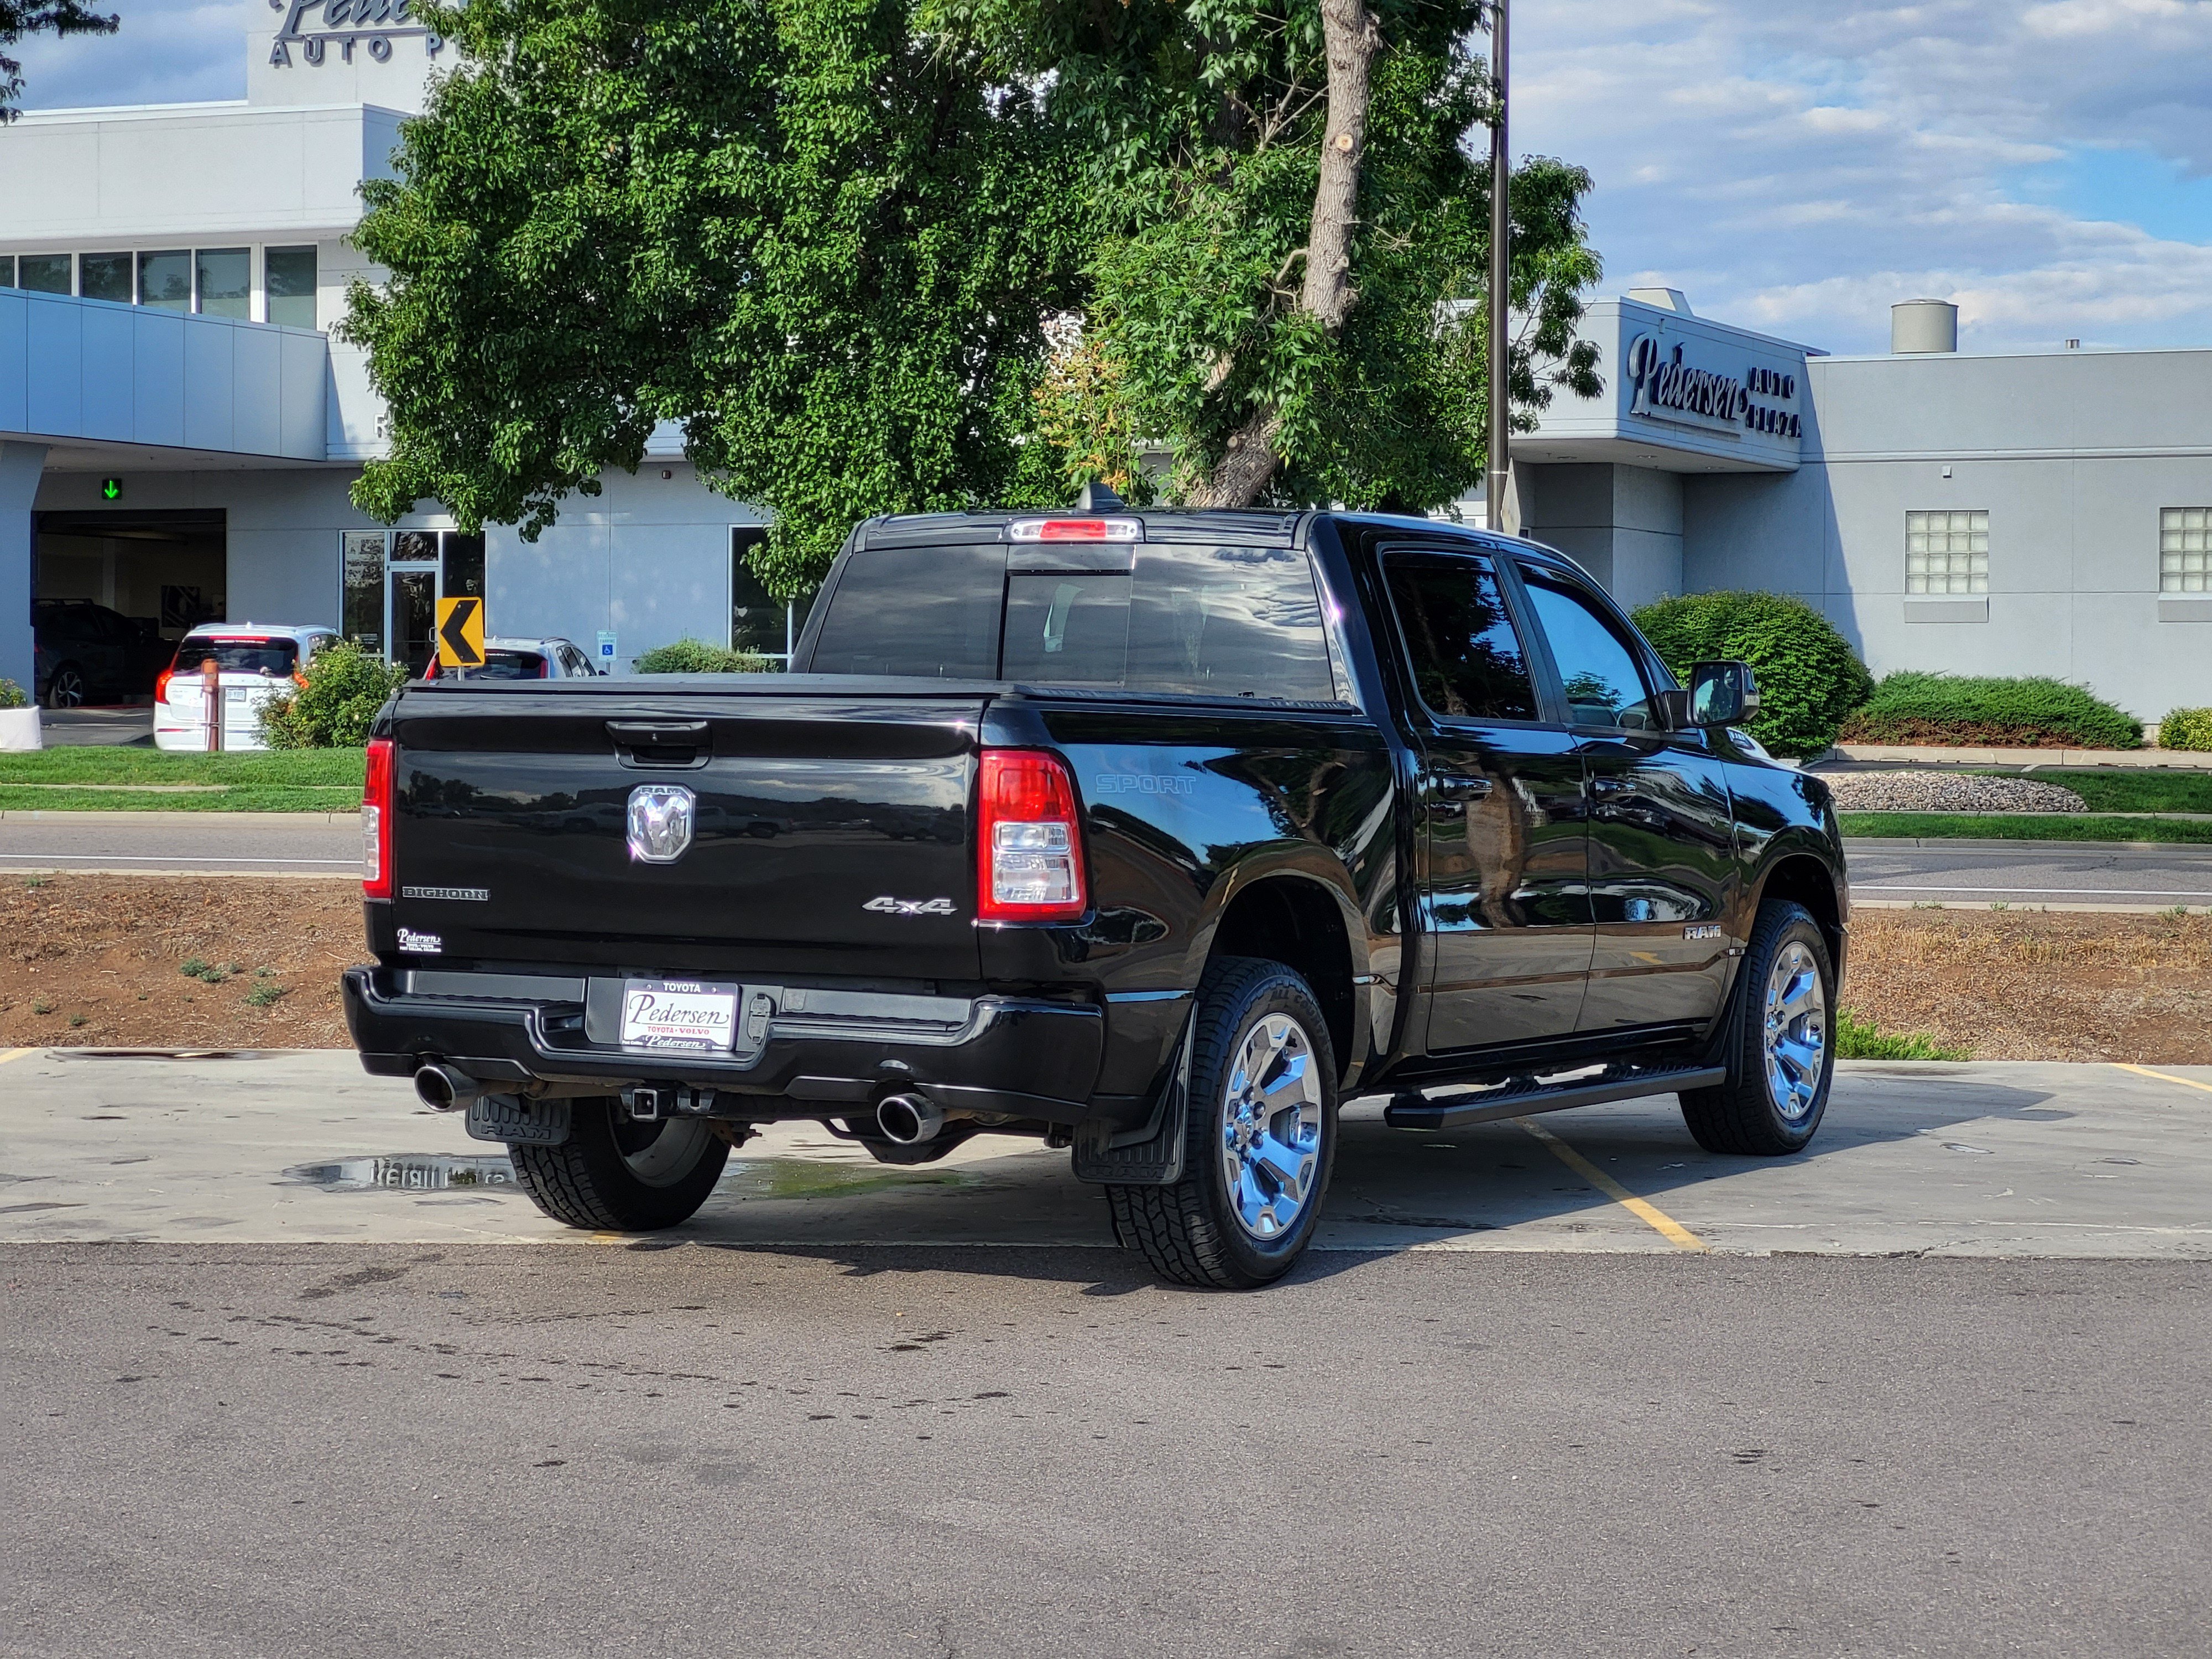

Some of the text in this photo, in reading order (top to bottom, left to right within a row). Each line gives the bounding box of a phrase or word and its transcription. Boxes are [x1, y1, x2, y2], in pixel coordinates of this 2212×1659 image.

[268, 35, 389, 66] AUTO
[1628, 331, 1750, 420] Pedersen
[1750, 366, 1796, 399] AUTO
[639, 787, 681, 795] RAM
[1095, 774, 1196, 794] SPORT
[402, 886, 488, 901] BIGHORN
[397, 928, 441, 943] Pedersen
[1683, 925, 1721, 940] RAM
[663, 983, 701, 993] TOYOTA
[629, 994, 729, 1024] Pedersen
[645, 1034, 706, 1048] Pedersen
[481, 1124, 551, 1139] RAM
[1088, 1165, 1164, 1178] RAM
